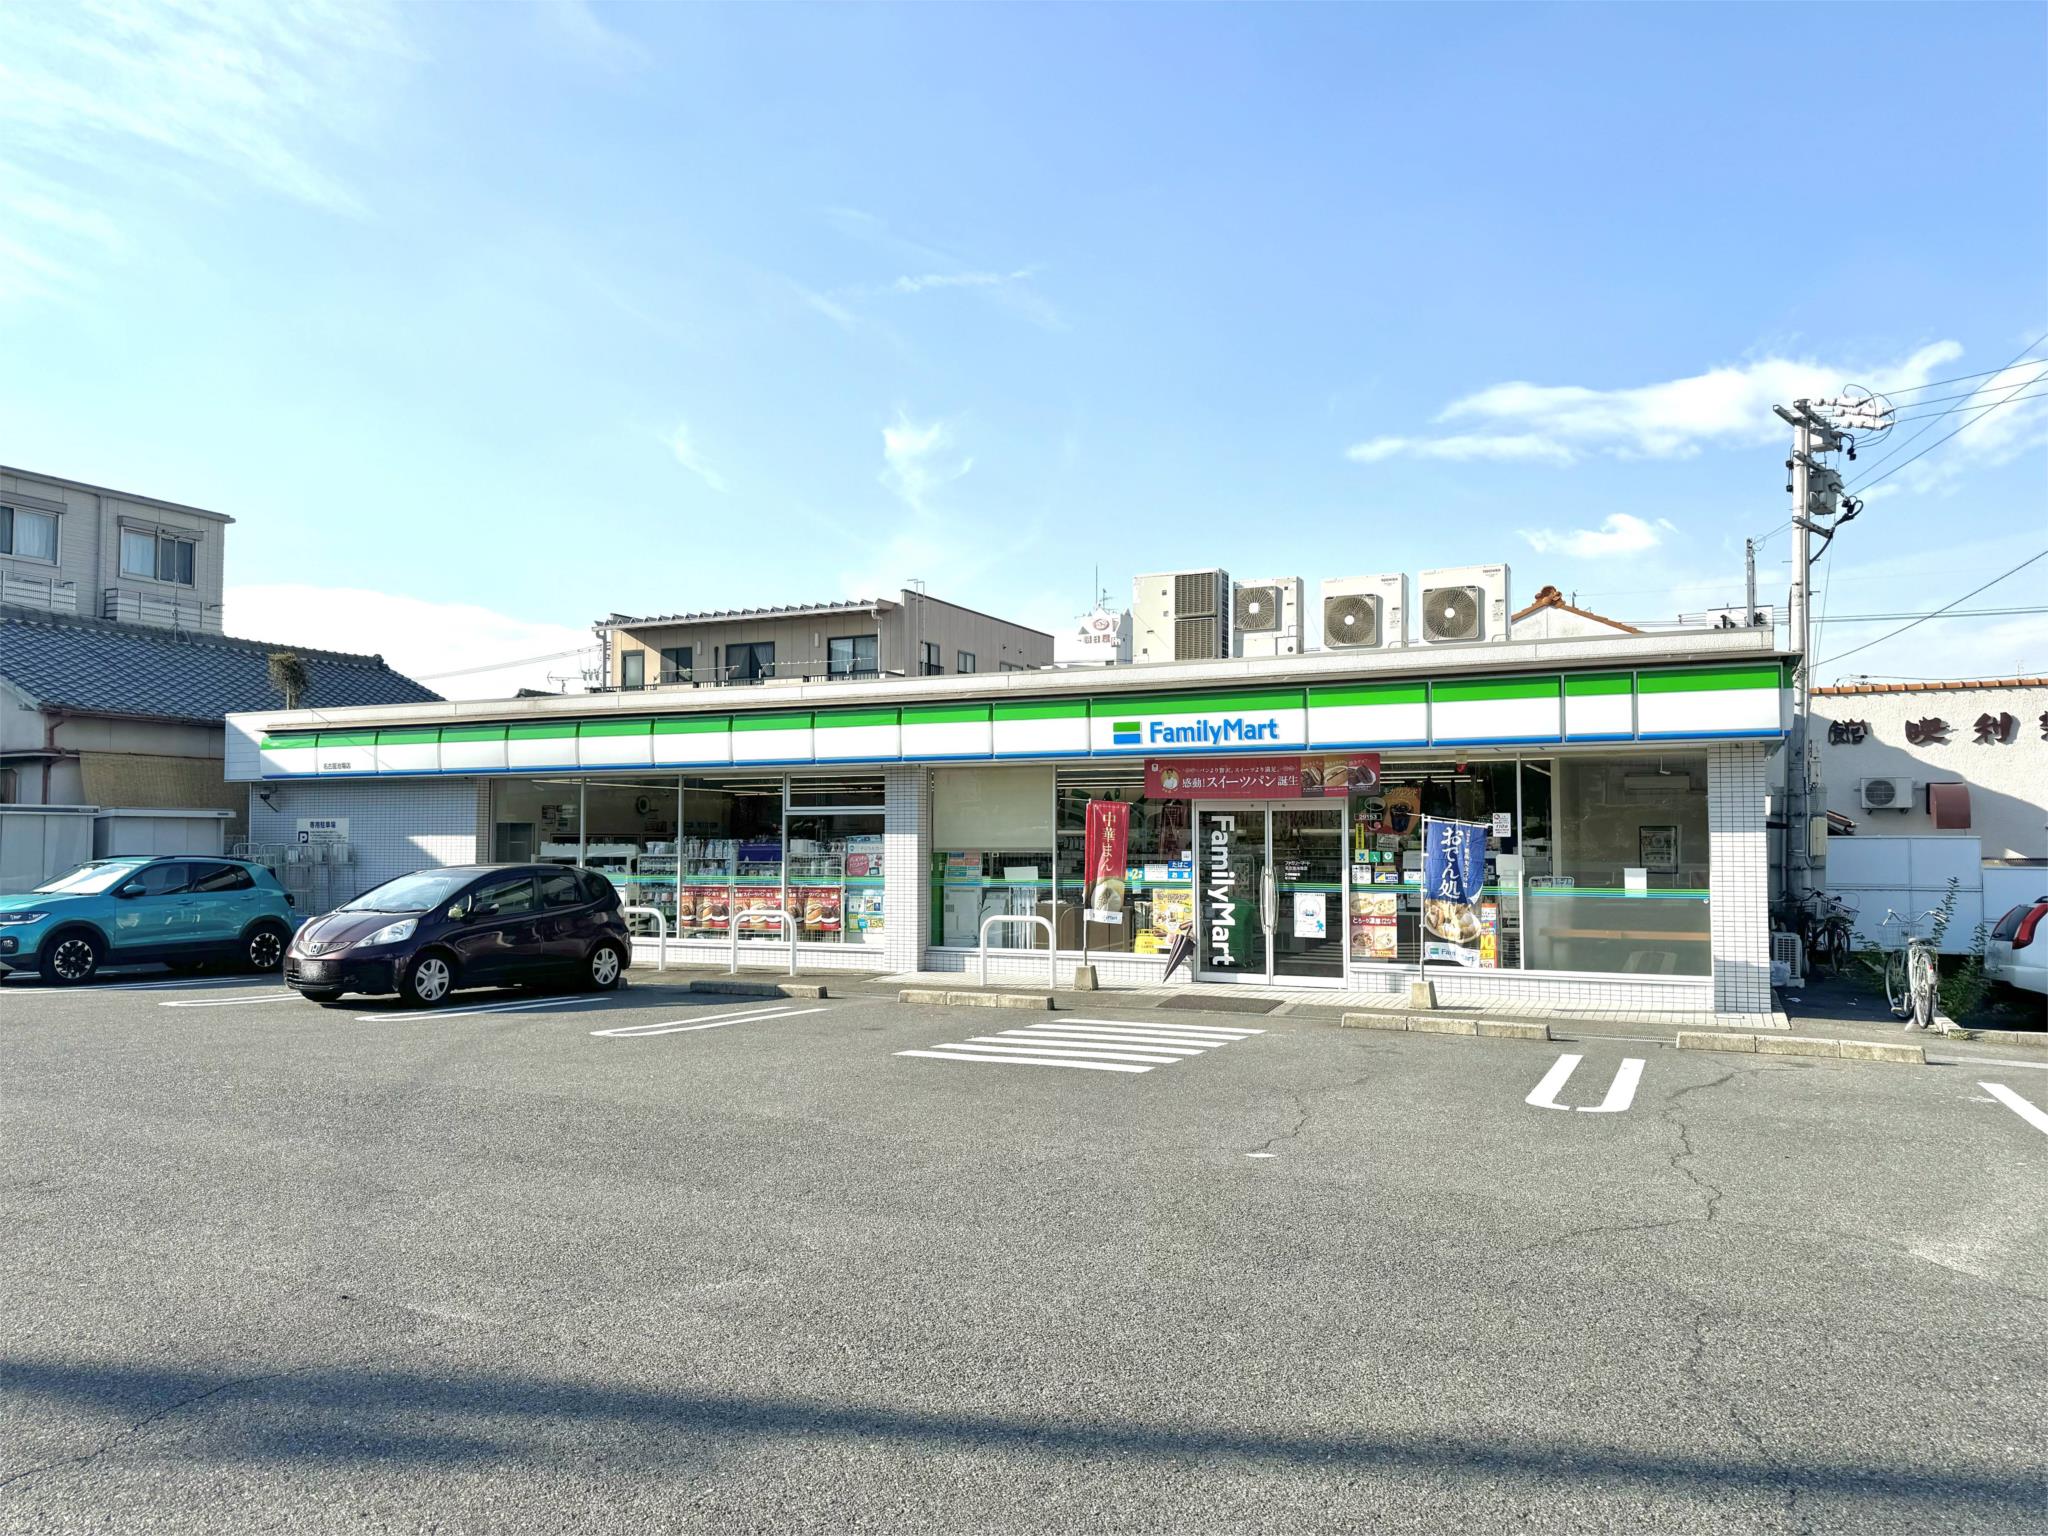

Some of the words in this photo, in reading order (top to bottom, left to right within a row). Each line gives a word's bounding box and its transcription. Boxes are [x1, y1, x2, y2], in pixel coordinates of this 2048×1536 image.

[1149, 718, 1280, 744] FamilyMart
[1099, 811, 1116, 872] 中華まん
[1438, 826, 1463, 899] おでん処
[1207, 815, 1236, 966] FamilyMart
